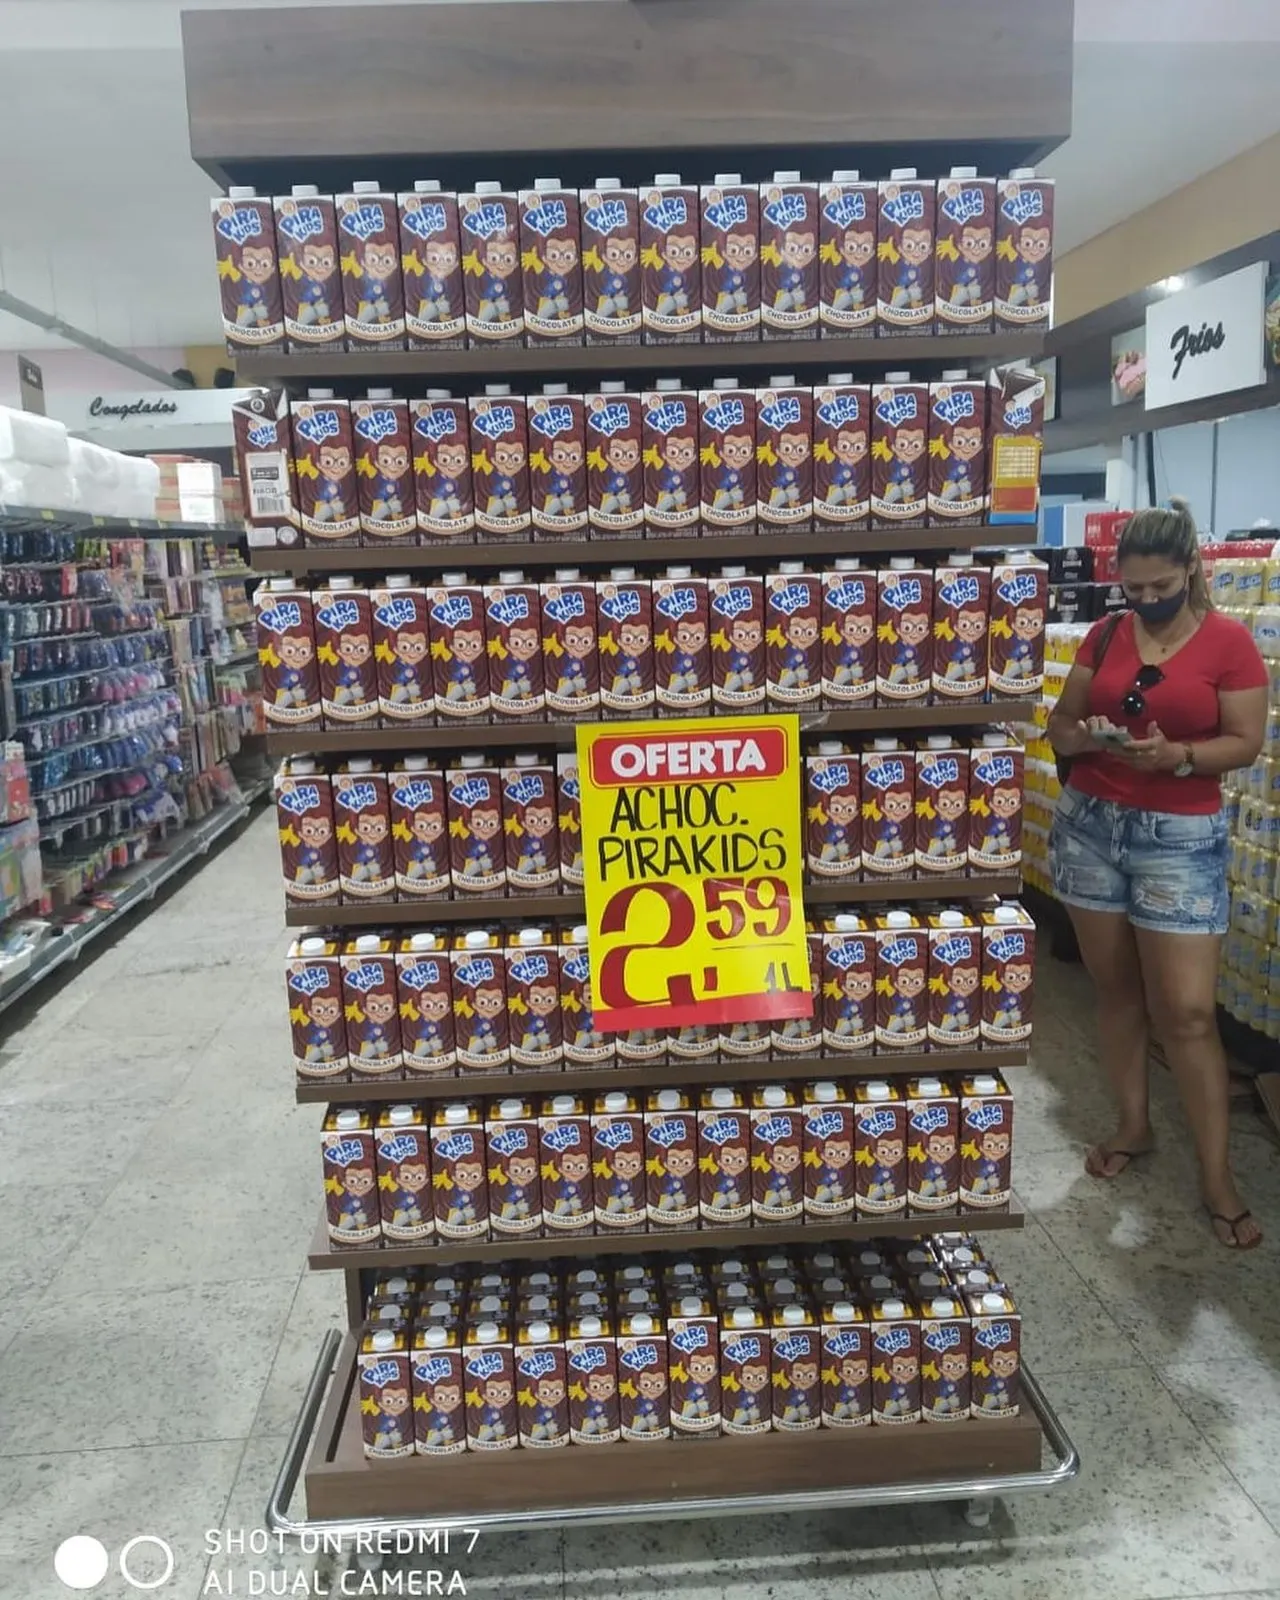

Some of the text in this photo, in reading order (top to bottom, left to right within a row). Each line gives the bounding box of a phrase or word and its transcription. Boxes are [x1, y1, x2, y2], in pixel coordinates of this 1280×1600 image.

[706, 196, 745, 220] PIRA
[824, 193, 863, 217] PIRA
[944, 190, 982, 214] PIRA
[343, 205, 383, 230] PIRA
[465, 204, 505, 229] PIRA
[586, 200, 626, 225] PIRA
[719, 209, 746, 226] KIDS
[837, 206, 863, 223] KIDS
[957, 204, 983, 220] KIDS
[218, 209, 259, 235] PIRA
[358, 219, 384, 236] KIDS
[479, 218, 505, 235] KIDS
[599, 213, 626, 231] KIDS
[234, 224, 260, 240] KIDS
[708, 312, 756, 322] CHOCOLATE
[824, 308, 871, 319] CHOCOLATE
[942, 305, 988, 315] CHOCOLATE
[351, 322, 399, 332] CHOCOLATE
[471, 320, 519, 331] CHOCOLATE
[590, 316, 638, 327] CHOCOLATE
[229, 326, 277, 336] CHOCOLATE
[1170, 321, 1225, 379] Frios
[89, 396, 178, 421] Congelados
[760, 398, 798, 422] PIRA
[934, 392, 972, 416] PIRA
[532, 405, 570, 429] PIRA
[647, 402, 684, 426] PIRA
[774, 411, 799, 427] KIDS
[947, 405, 972, 421] KIDS
[297, 411, 336, 436] PIRA
[416, 409, 454, 434] PIRA
[546, 418, 571, 434] KIDS
[660, 414, 685, 431] KIDS
[312, 424, 337, 440] KIDS
[430, 422, 455, 438] KIDS
[761, 506, 806, 516] CHOCOLATE
[934, 499, 978, 510] CHOCOLATE
[423, 518, 469, 528] CHOCOLATE
[537, 513, 582, 523] CHOCOLATE
[649, 510, 694, 520] CHOCOLATE
[307, 520, 354, 530] CHOCOLATE
[883, 580, 920, 604] PIRA
[999, 575, 1036, 599] PIRA
[658, 589, 696, 613] PIRA
[771, 584, 808, 608] PIRA
[895, 593, 920, 608] KIDS
[1011, 588, 1036, 603] KIDS
[317, 600, 356, 624] PIRA
[432, 597, 471, 621] PIRA
[546, 593, 584, 617] PIRA
[671, 601, 696, 617] KIDS
[784, 597, 808, 612] KIDS
[332, 613, 357, 628] KIDS
[447, 610, 471, 625] KIDS
[559, 606, 584, 621] KIDS
[882, 683, 925, 692] CHOCOLATE
[995, 677, 1038, 687] CHOCOLATE
[661, 692, 705, 702] CHOCOLATE
[772, 687, 816, 697] CHOCOLATE
[326, 704, 371, 714] CHOCOLATE
[439, 701, 484, 711] CHOCOLATE
[550, 696, 595, 706] CHOCOLATE
[610, 738, 767, 777] OFERTA
[810, 763, 847, 787] PIRA
[919, 758, 956, 782] PIRA
[976, 757, 1012, 781] PIRA
[989, 769, 1012, 784] KIDS
[824, 775, 847, 790] KIDS
[932, 770, 956, 785] KIDS
[338, 782, 375, 806] PIRA
[394, 781, 431, 804] PIRA
[505, 776, 542, 799] PIRA
[519, 788, 543, 802] KIDS
[280, 785, 317, 809] PIRA
[294, 798, 319, 812] KIDS
[351, 795, 376, 809] KIDS
[407, 793, 432, 807] KIDS
[609, 782, 749, 833] ACHOC.
[598, 828, 787, 881] PIRAKIDS
[973, 853, 1016, 862] CHOCOLATE
[810, 860, 853, 869] CHOCOLATE
[400, 878, 444, 888] CHOCOLATE
[510, 873, 553, 882] CHOCOLATE
[288, 883, 332, 893] CHOCOLATE
[828, 942, 864, 965] PIRA
[881, 939, 917, 962] PIRA
[935, 938, 971, 961] PIRA
[988, 935, 1024, 958] PIRA
[1001, 946, 1024, 960] KIDS
[841, 953, 864, 967] KIDS
[894, 950, 917, 964] KIDS
[948, 949, 971, 963] KIDS
[291, 968, 328, 991] PIRA
[401, 963, 438, 986] PIRA
[456, 960, 493, 983] PIRA
[469, 971, 493, 986] KIDS
[305, 979, 328, 994] KIDS
[414, 974, 438, 989] KIDS
[860, 1112, 895, 1134] PIRA
[967, 1106, 1002, 1127] PIRA
[979, 1116, 1002, 1130] KIDS
[543, 1125, 579, 1147] PIRA
[650, 1120, 685, 1142] PIRA
[755, 1117, 790, 1139] PIRA
[767, 1127, 790, 1142] KIDS
[872, 1122, 896, 1137] KIDS
[437, 1134, 472, 1156] PIRA
[555, 1136, 579, 1150] KIDS
[661, 1131, 685, 1145] KIDS
[325, 1140, 361, 1162] PIRA
[339, 1151, 362, 1166] KIDS
[449, 1145, 473, 1159] KIDS
[673, 1326, 707, 1349] PIRA
[875, 1329, 909, 1350] PIRA
[976, 1324, 1010, 1345] PIRA
[988, 1334, 1010, 1348] KIDS
[684, 1337, 707, 1352] KIDS
[775, 1336, 809, 1358] PIRA
[887, 1339, 909, 1353] KIDS
[570, 1347, 605, 1369] PIRA
[787, 1346, 809, 1360] KIDS
[467, 1354, 502, 1376] PIRA
[479, 1364, 502, 1378] KIDS
[582, 1357, 605, 1371] KIDS
[363, 1362, 398, 1384] PIRA
[375, 1372, 398, 1386] KIDS
